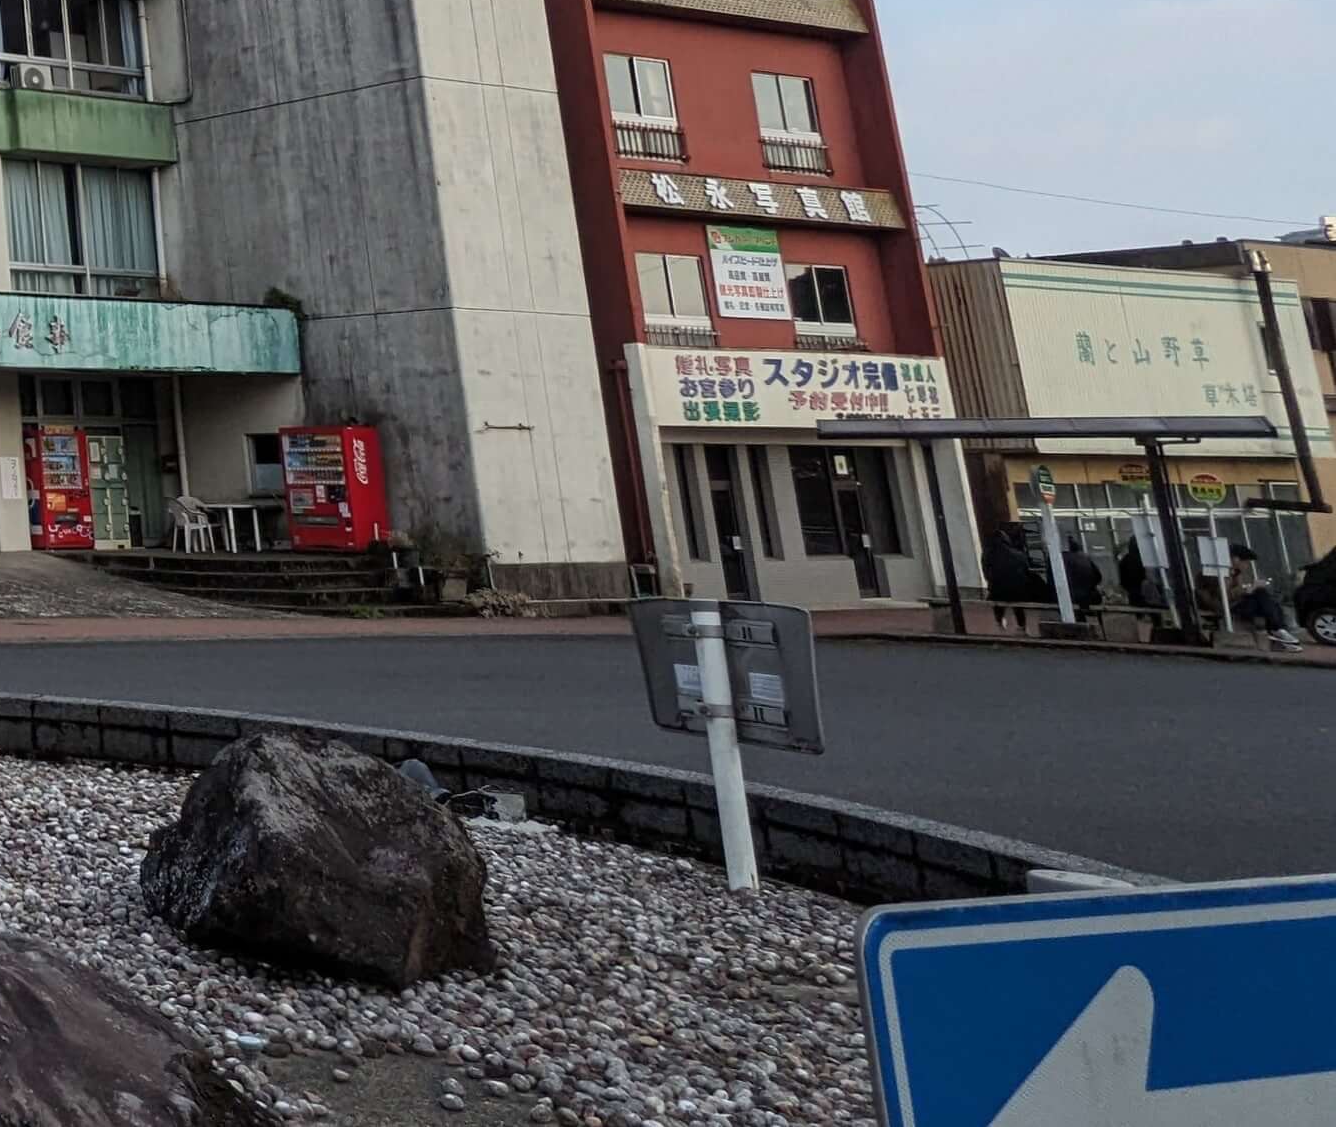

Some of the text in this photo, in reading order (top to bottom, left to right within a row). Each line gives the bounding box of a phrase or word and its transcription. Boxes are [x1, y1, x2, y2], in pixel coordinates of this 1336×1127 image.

[650, 173, 873, 223] 松永写真館
[679, 377, 755, 399] お宮参り
